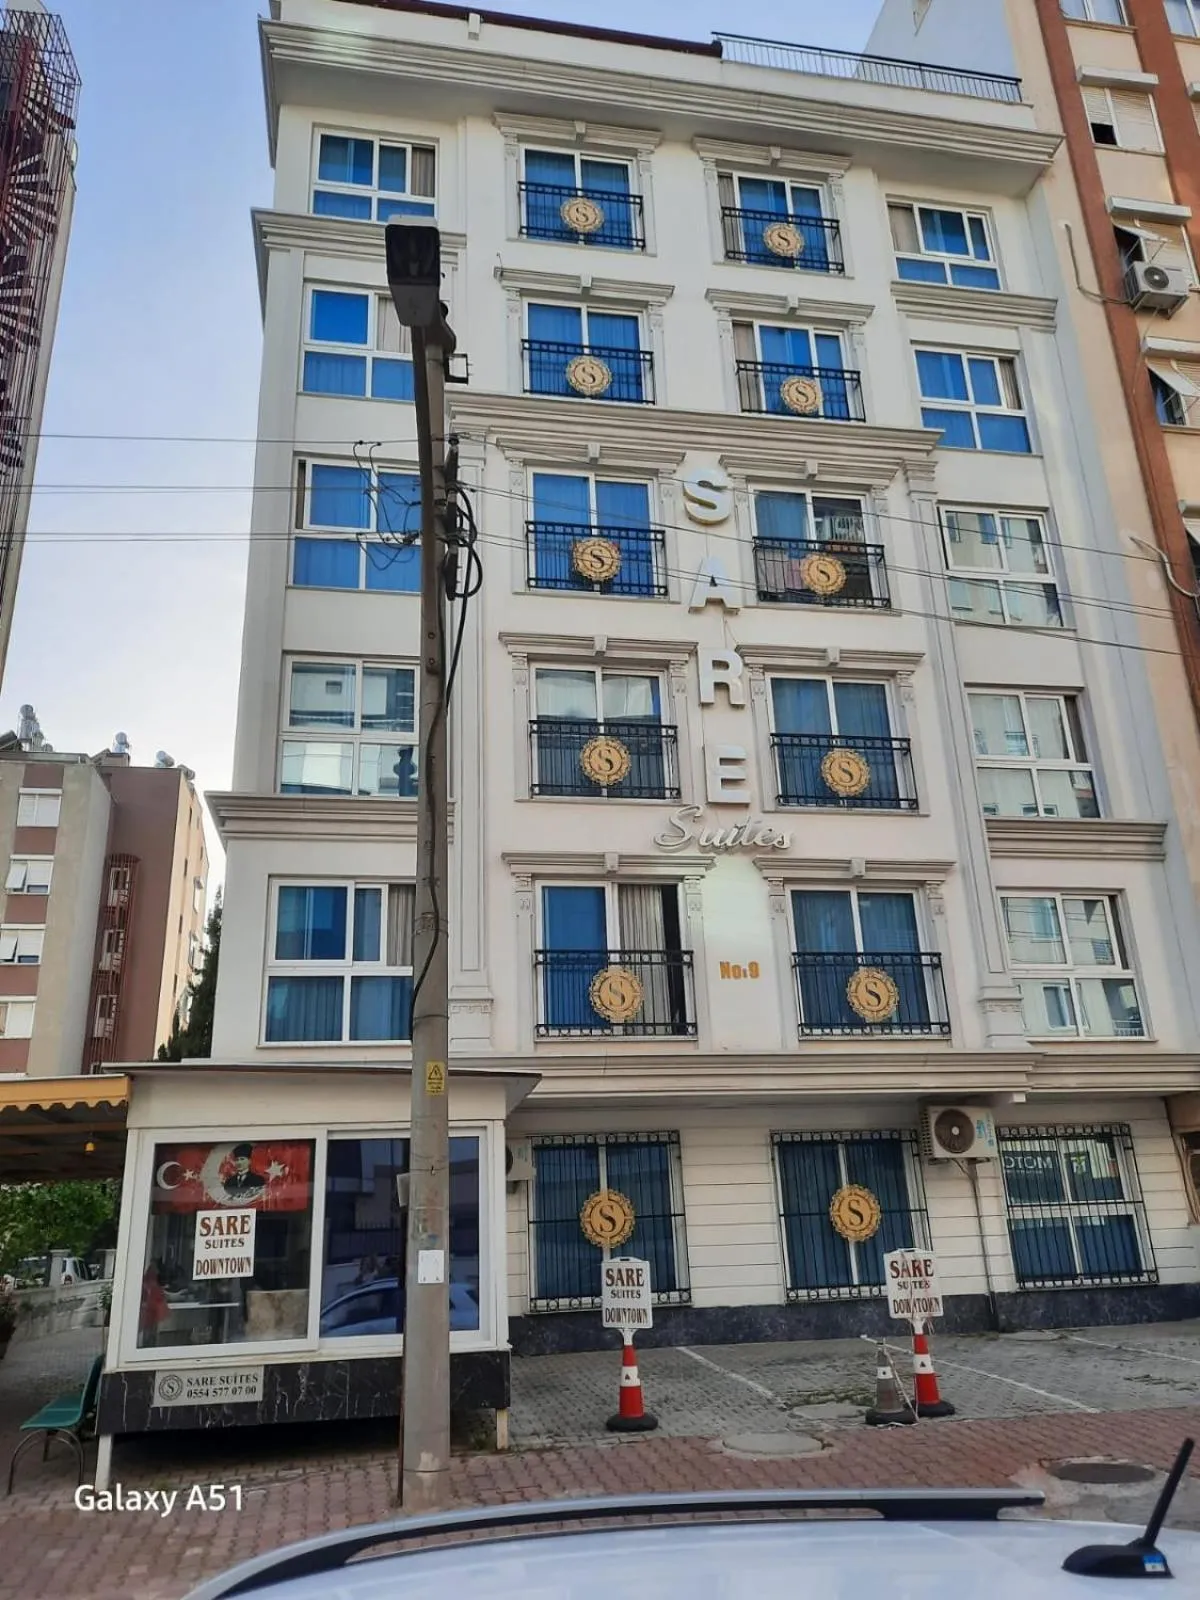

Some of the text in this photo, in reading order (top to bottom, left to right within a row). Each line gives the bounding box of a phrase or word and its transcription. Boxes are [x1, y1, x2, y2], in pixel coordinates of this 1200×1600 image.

[683, 468, 752, 804] SARE
[654, 804, 793, 852] Suites
[200, 1215, 251, 1237] SARE
[204, 1238, 245, 1250] SUITES
[195, 1257, 252, 1276] DOWNTOWN
[889, 1259, 934, 1279] SARE
[605, 1268, 645, 1287] SARE
[610, 1289, 641, 1299] SUITES
[605, 1307, 649, 1324] DOWNTOWN
[186, 1376, 217, 1387] SARE
[186, 1389, 209, 1398] 0554
[212, 1388, 229, 1397] 577
[231, 1386, 243, 1395] 07
